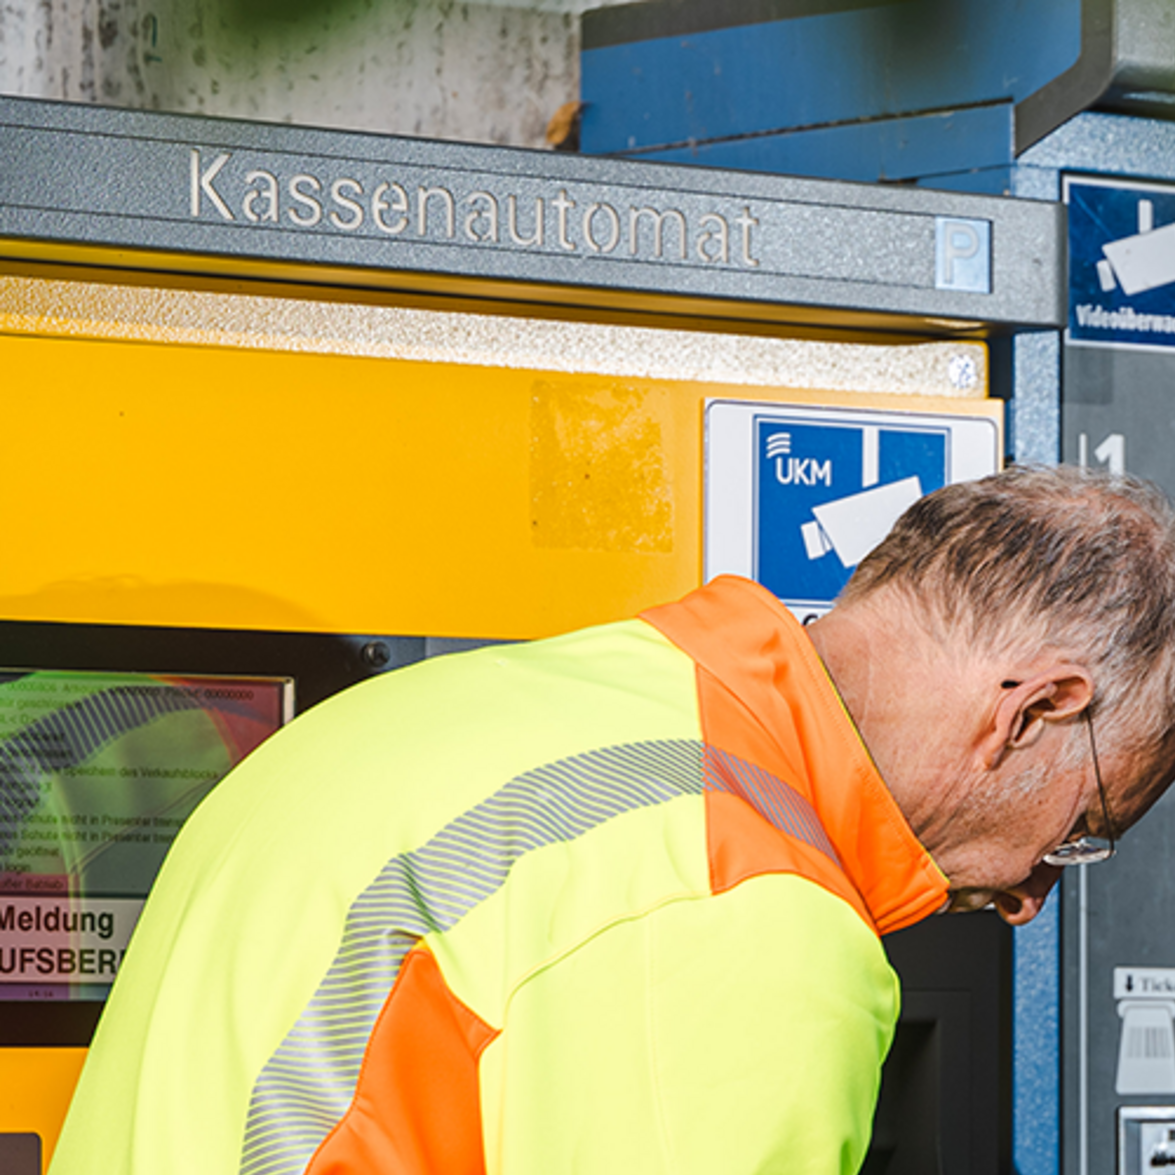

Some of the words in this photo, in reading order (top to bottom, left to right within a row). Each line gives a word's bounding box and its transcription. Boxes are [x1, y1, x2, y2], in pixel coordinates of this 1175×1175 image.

[189, 149, 760, 267] Kassenautomat
[943, 221, 979, 284] P
[775, 457, 832, 487] UKM
[0, 905, 114, 940] Meldung
[0, 947, 125, 975] UFSBER
